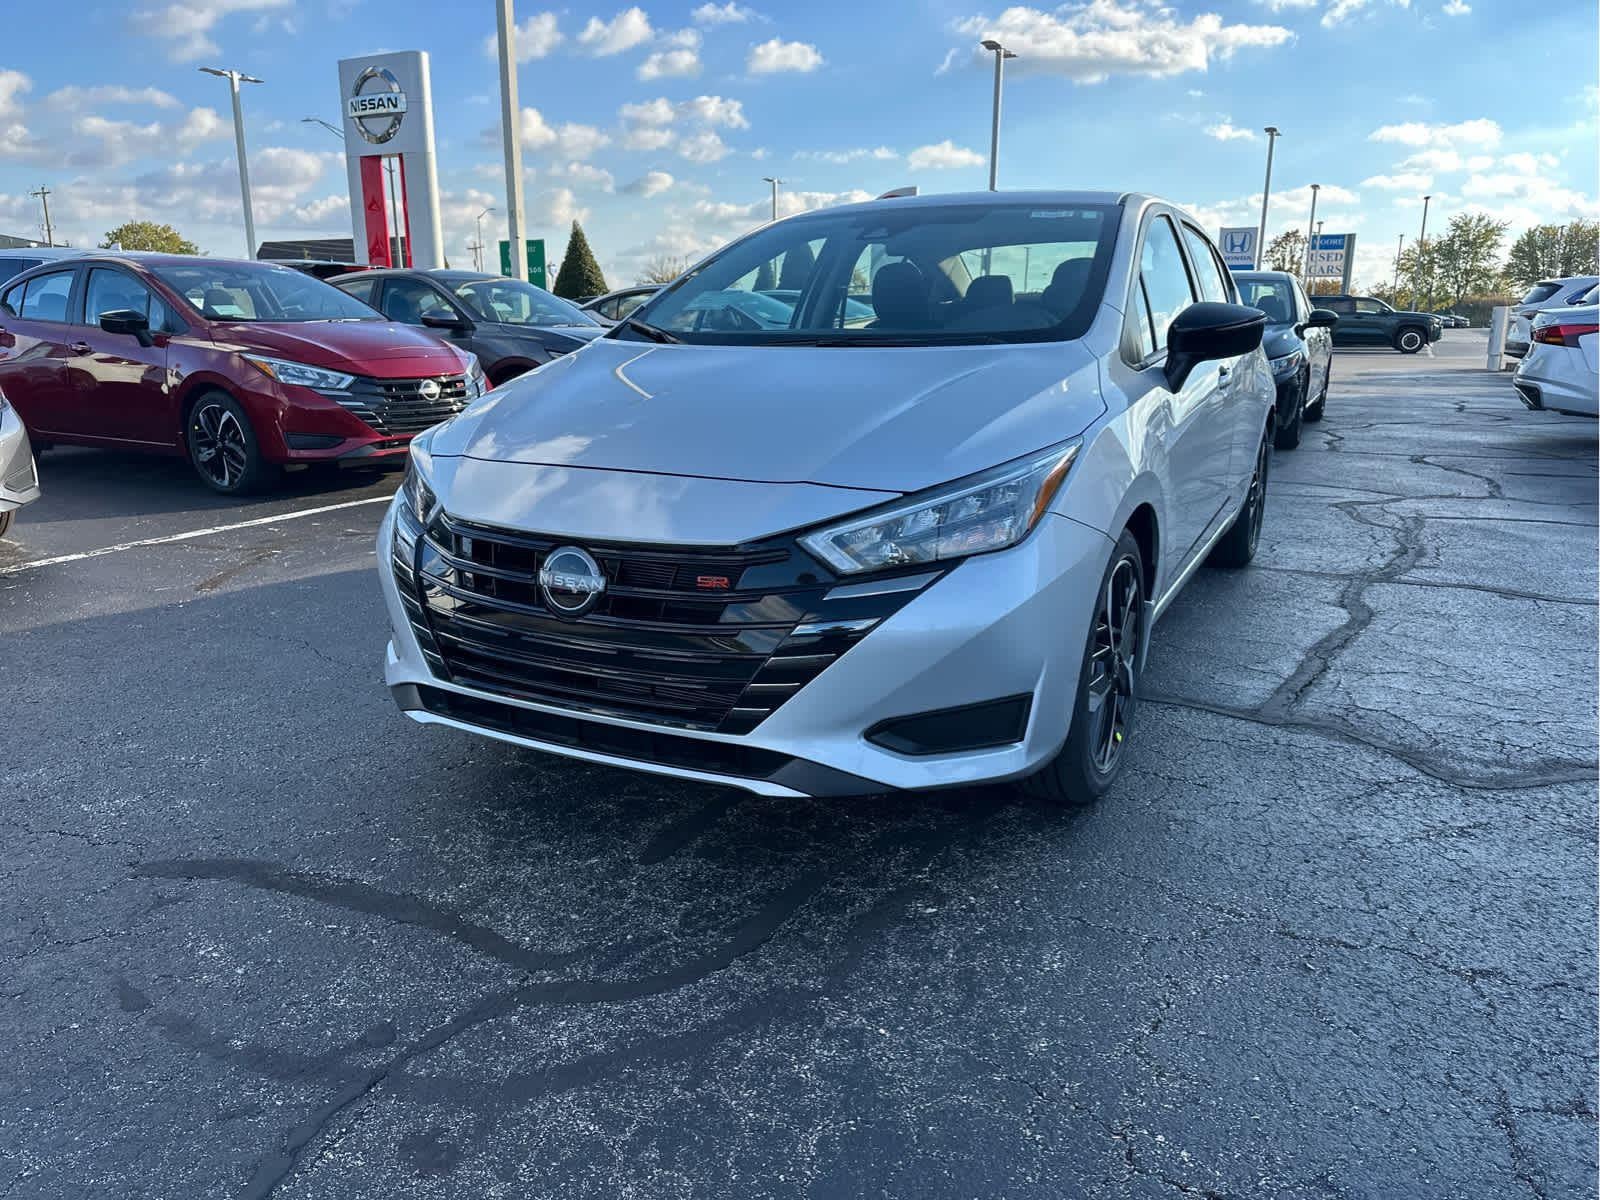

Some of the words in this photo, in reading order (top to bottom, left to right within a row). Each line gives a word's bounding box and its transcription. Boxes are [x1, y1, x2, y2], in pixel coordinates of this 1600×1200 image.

[351, 97, 398, 113] NISSAN
[1310, 252, 1344, 262] USED
[1308, 265, 1342, 274] CARS
[539, 569, 604, 591] NISSAN
[697, 575, 729, 589] SR
